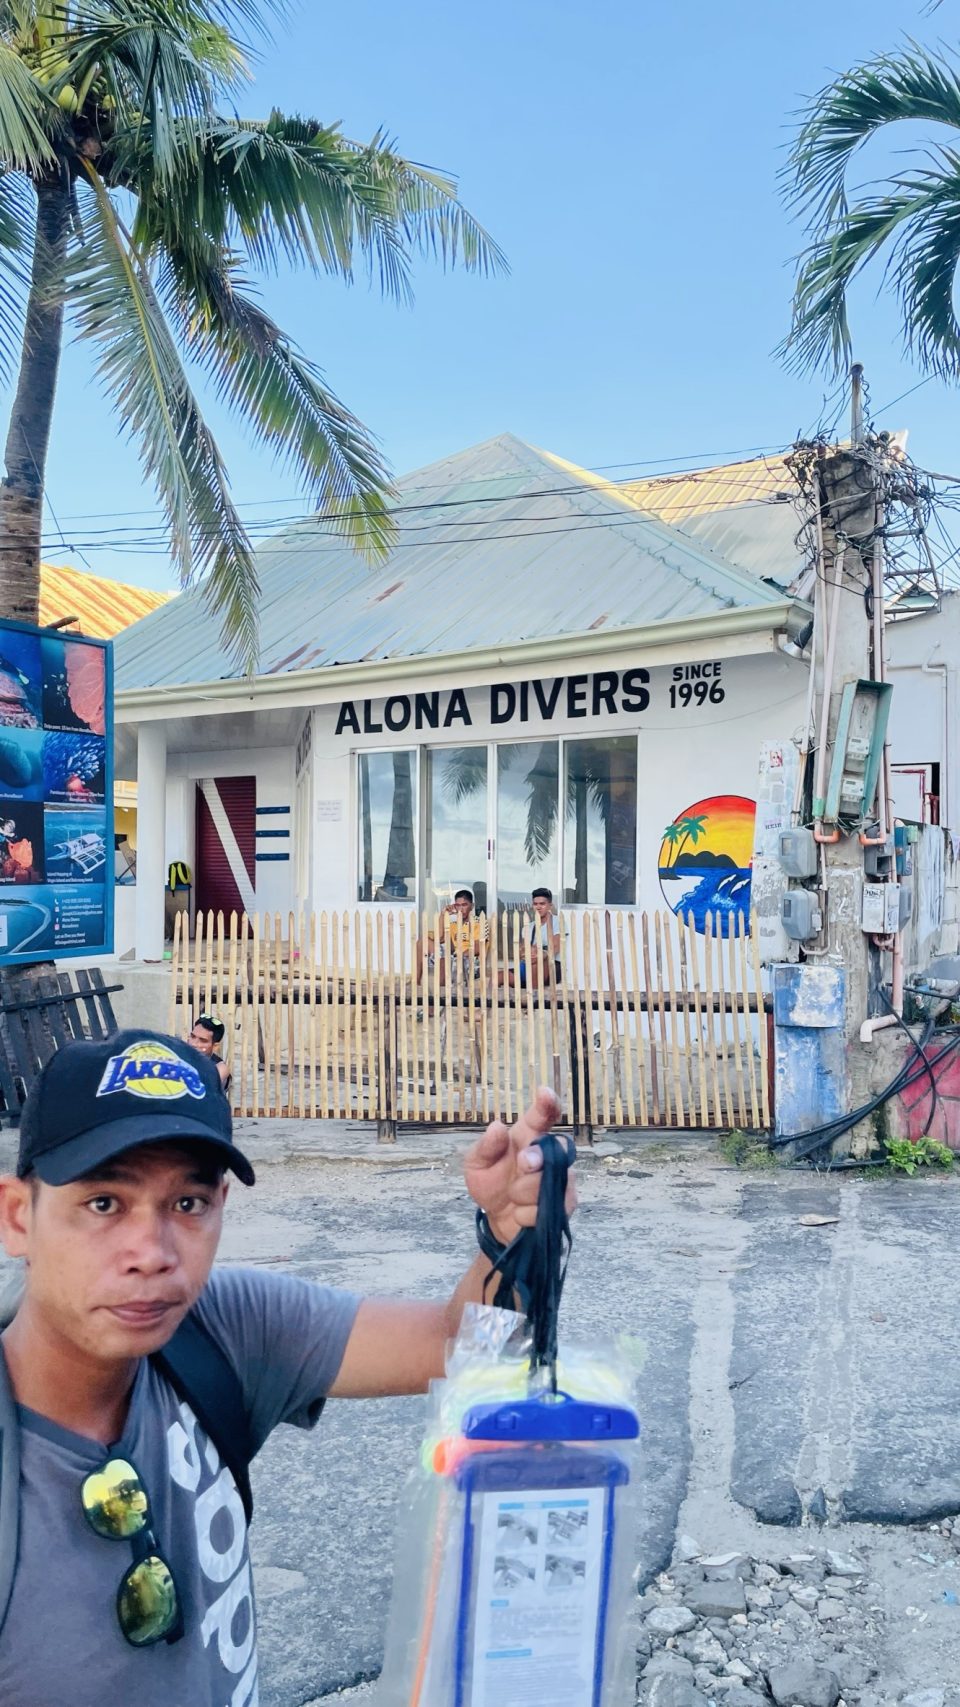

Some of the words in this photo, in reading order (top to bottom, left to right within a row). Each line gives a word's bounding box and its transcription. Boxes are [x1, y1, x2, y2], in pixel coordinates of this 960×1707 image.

[673, 662, 722, 682] SINCE
[334, 688, 473, 736] ALONA
[490, 667, 651, 725] DIVERS
[669, 679, 726, 709] 1996
[98, 1055, 206, 1098] LAKERS
